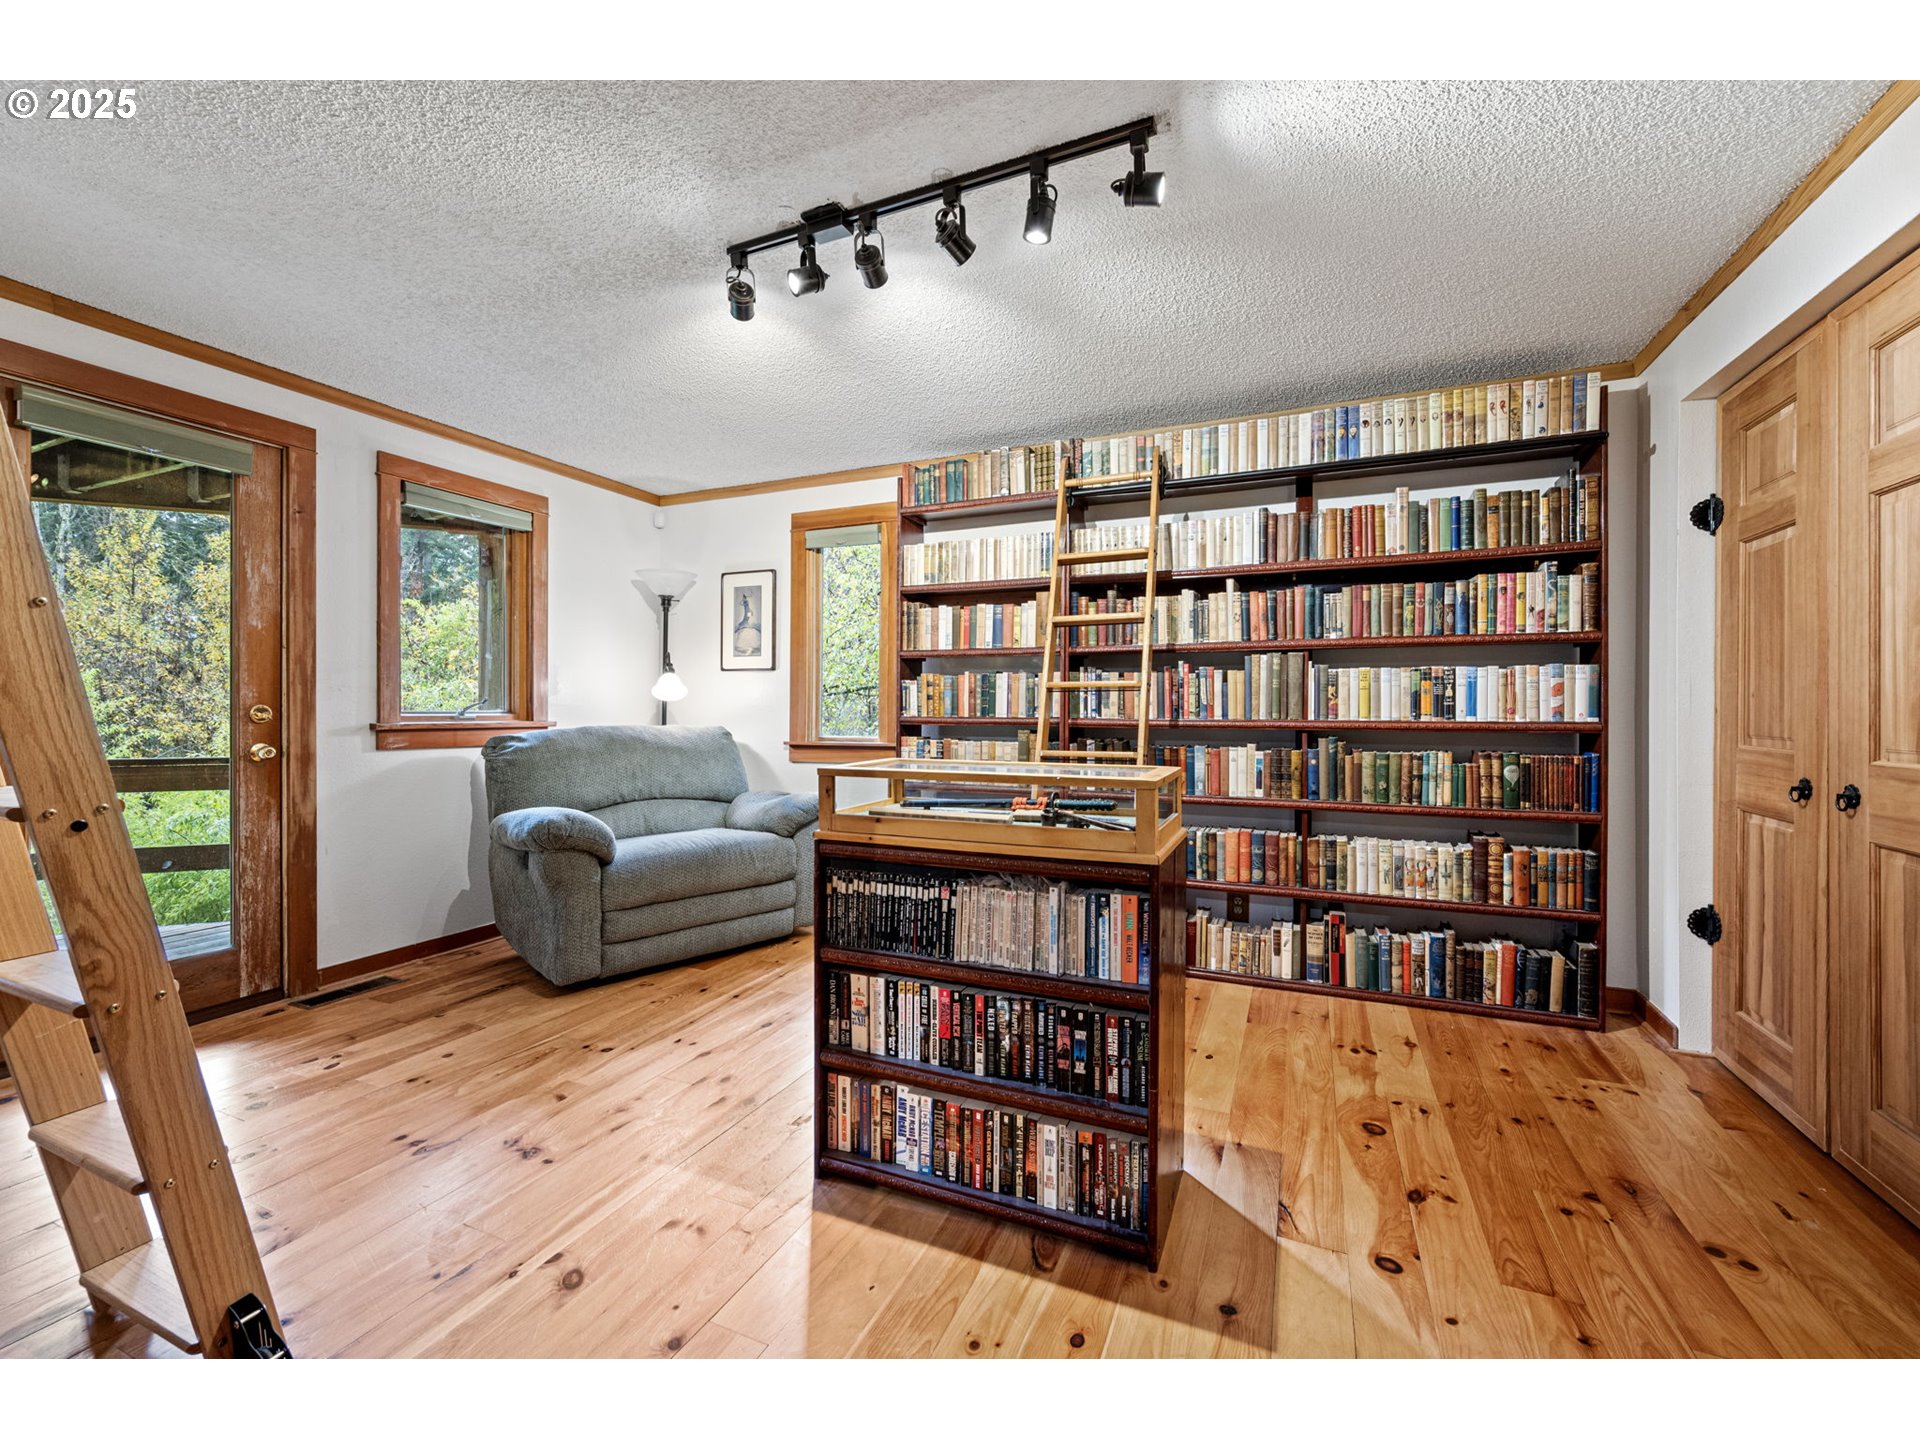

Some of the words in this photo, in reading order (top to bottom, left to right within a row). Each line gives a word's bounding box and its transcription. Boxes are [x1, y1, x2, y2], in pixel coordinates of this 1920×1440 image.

[882, 1094, 892, 1114] ANDY
[898, 1097, 906, 1113] ANDY
[921, 1107, 930, 1124] ICE
[882, 1115, 892, 1140] McNAB
[898, 1115, 906, 1138] McNAB
[934, 1110, 944, 1142] TEMPLE
[921, 1124, 930, 1156] STATION
